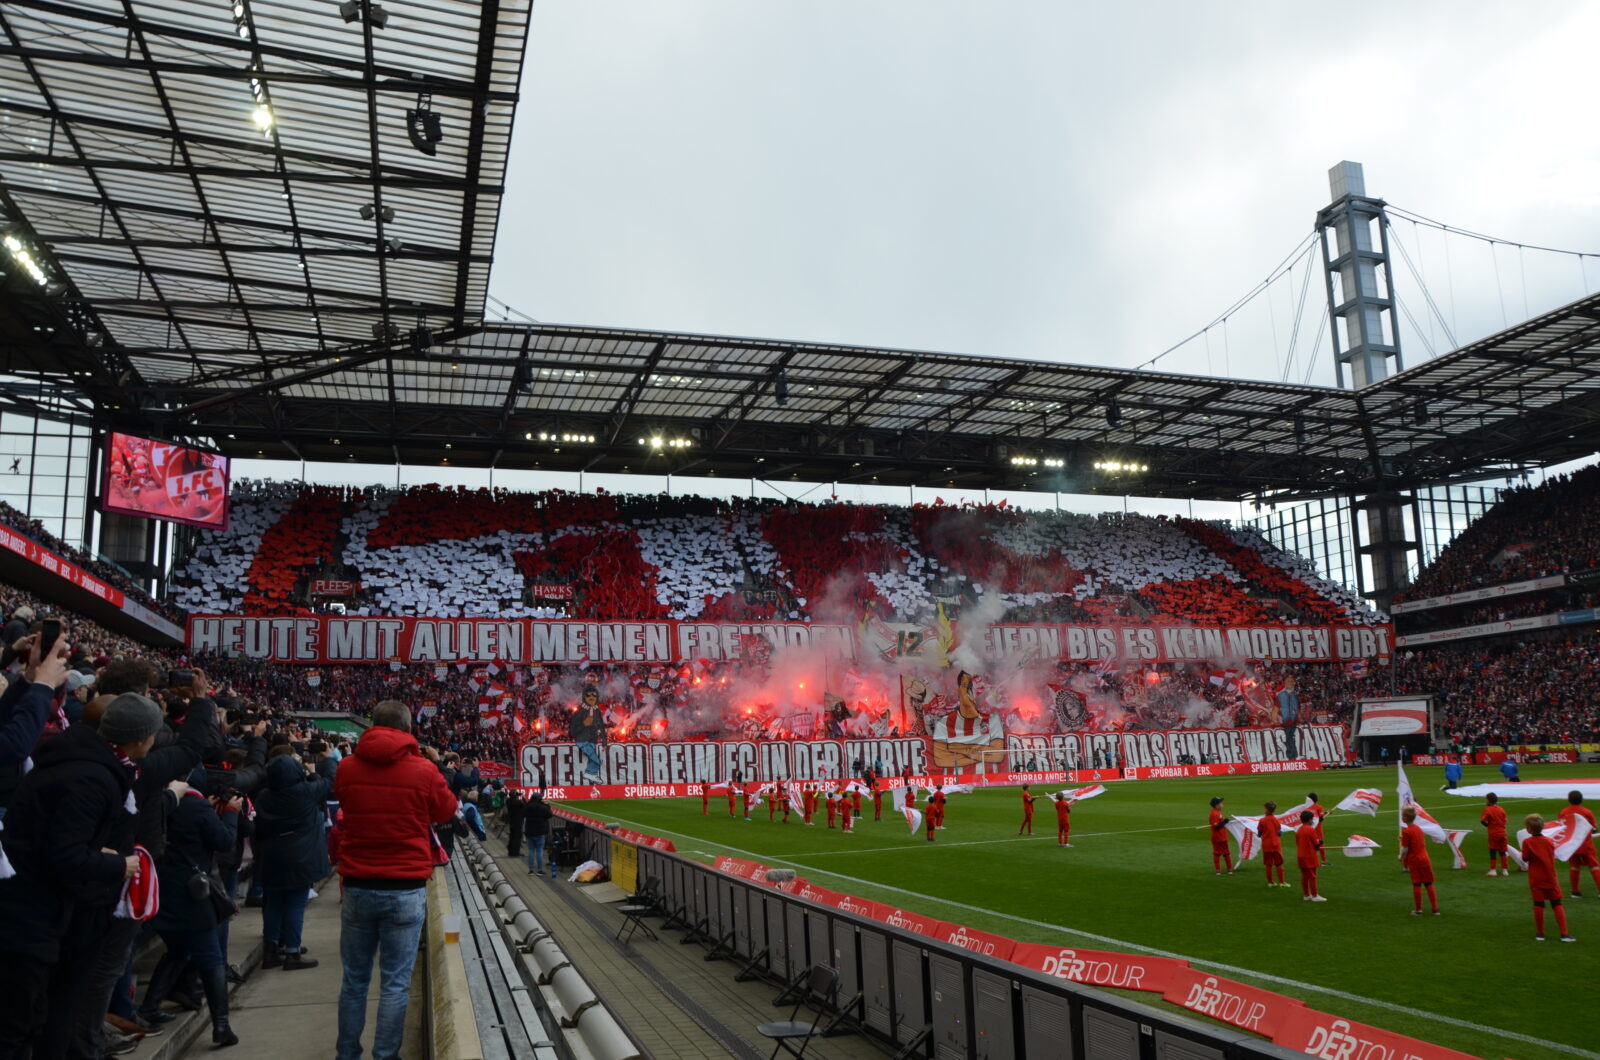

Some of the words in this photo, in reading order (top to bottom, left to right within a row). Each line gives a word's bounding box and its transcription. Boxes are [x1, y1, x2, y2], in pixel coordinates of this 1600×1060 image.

[534, 585, 573, 597] HAWKS
[192, 618, 320, 661] HEUTE
[327, 618, 404, 662] MIT
[409, 621, 523, 663] ALLEN
[531, 622, 672, 663] MEINEN
[678, 624, 856, 662] FRENDEN
[1066, 626, 1118, 661] BIS
[1121, 626, 1161, 661] ES
[1161, 627, 1224, 661] KEIN
[1225, 627, 1333, 661] MORGEN
[1335, 627, 1390, 661] GIBT
[896, 630, 924, 657] 12
[651, 743, 720, 783] BEIM
[723, 742, 757, 782] FC
[760, 742, 791, 781] IN
[793, 741, 843, 781] DER
[845, 739, 928, 779] KURVE
[1007, 734, 1049, 772] DER
[1052, 733, 1081, 771] FC
[1085, 733, 1121, 770] IST
[1123, 732, 1167, 768] DAS
[1168, 730, 1243, 765] EINZIGE
[1244, 727, 1288, 762] WAS
[1150, 766, 1183, 778] SPÜRBAR
[1251, 761, 1280, 773] SPÜRBAR
[1282, 760, 1309, 772] ANDERS.
[625, 786, 667, 798] SPÜRBAR
[888, 776, 926, 789] SPÜBAR
[1042, 952, 1145, 988] DERTOUR
[1184, 979, 1266, 1030] DERTOUR
